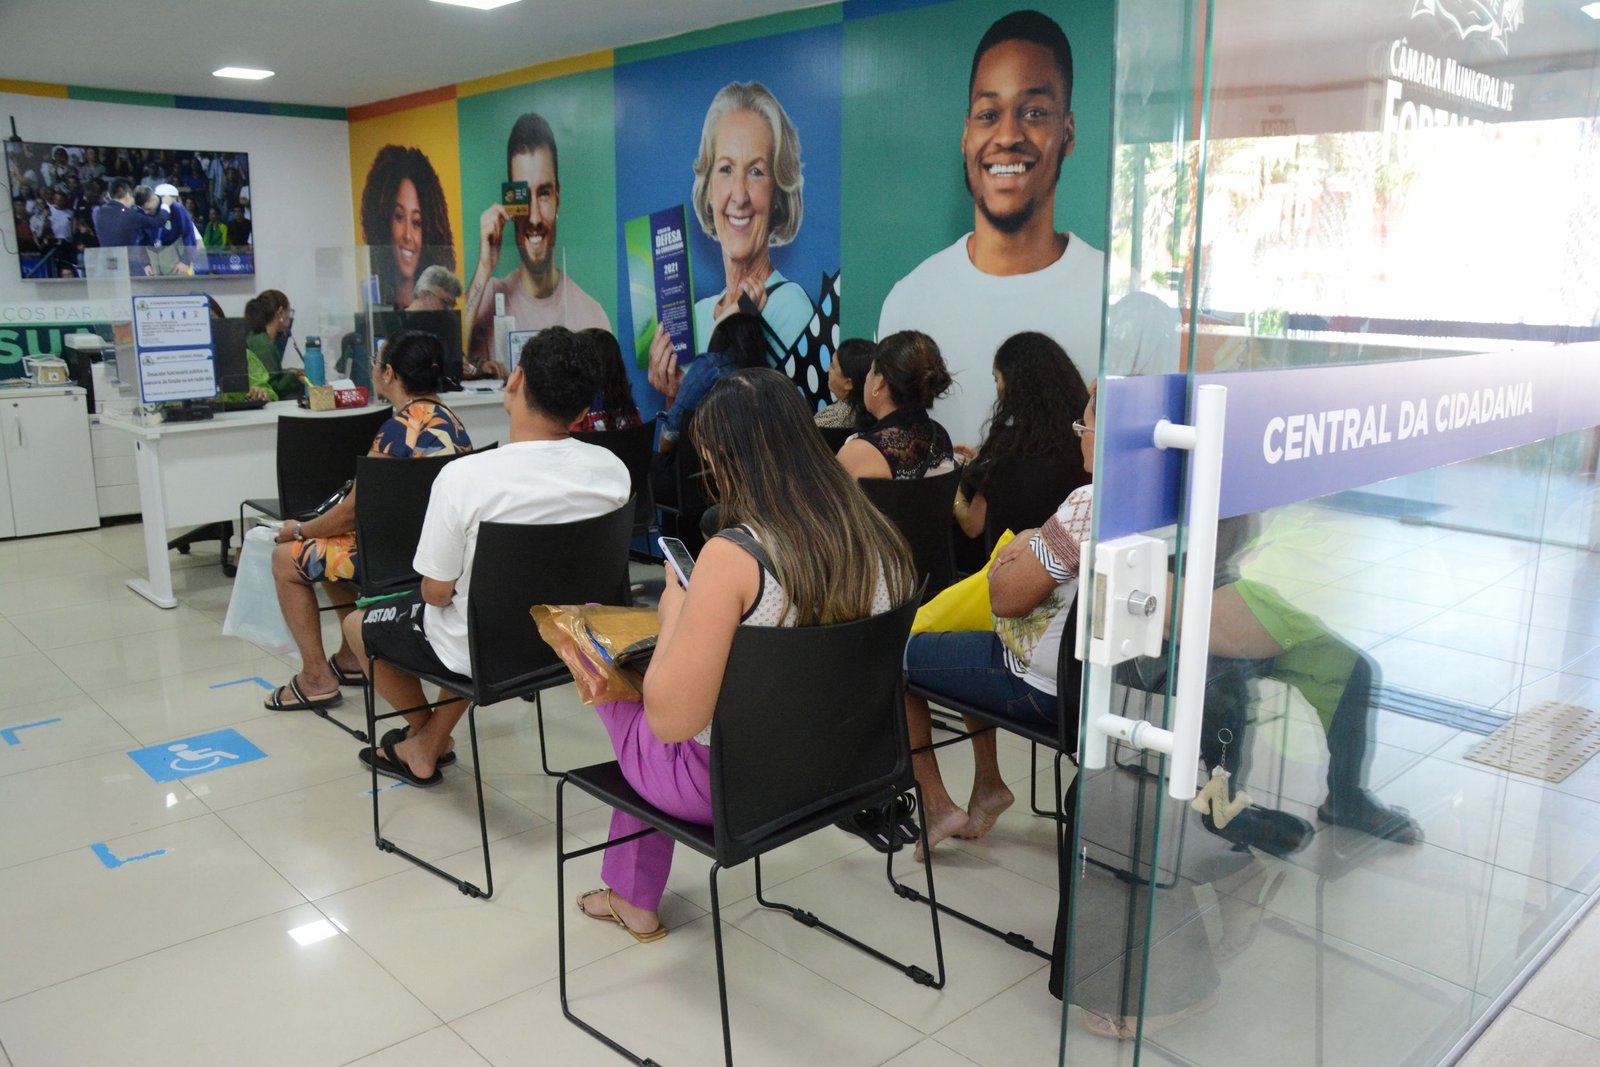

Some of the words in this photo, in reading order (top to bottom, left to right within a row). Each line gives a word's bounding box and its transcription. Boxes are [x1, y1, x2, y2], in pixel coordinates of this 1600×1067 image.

[1390, 37, 1441, 90] CÂMARA
[1443, 58, 1500, 107] MUNICIPAL
[1501, 81, 1515, 111] DE
[655, 229, 682, 248] DEFESA
[664, 262, 678, 275] 2021
[54, 306, 108, 320] PARA
[1263, 404, 1392, 465] CENTRAL
[1398, 398, 1429, 441] DA
[1435, 382, 1533, 433] CIDADANIA
[381, 606, 397, 621] DO
